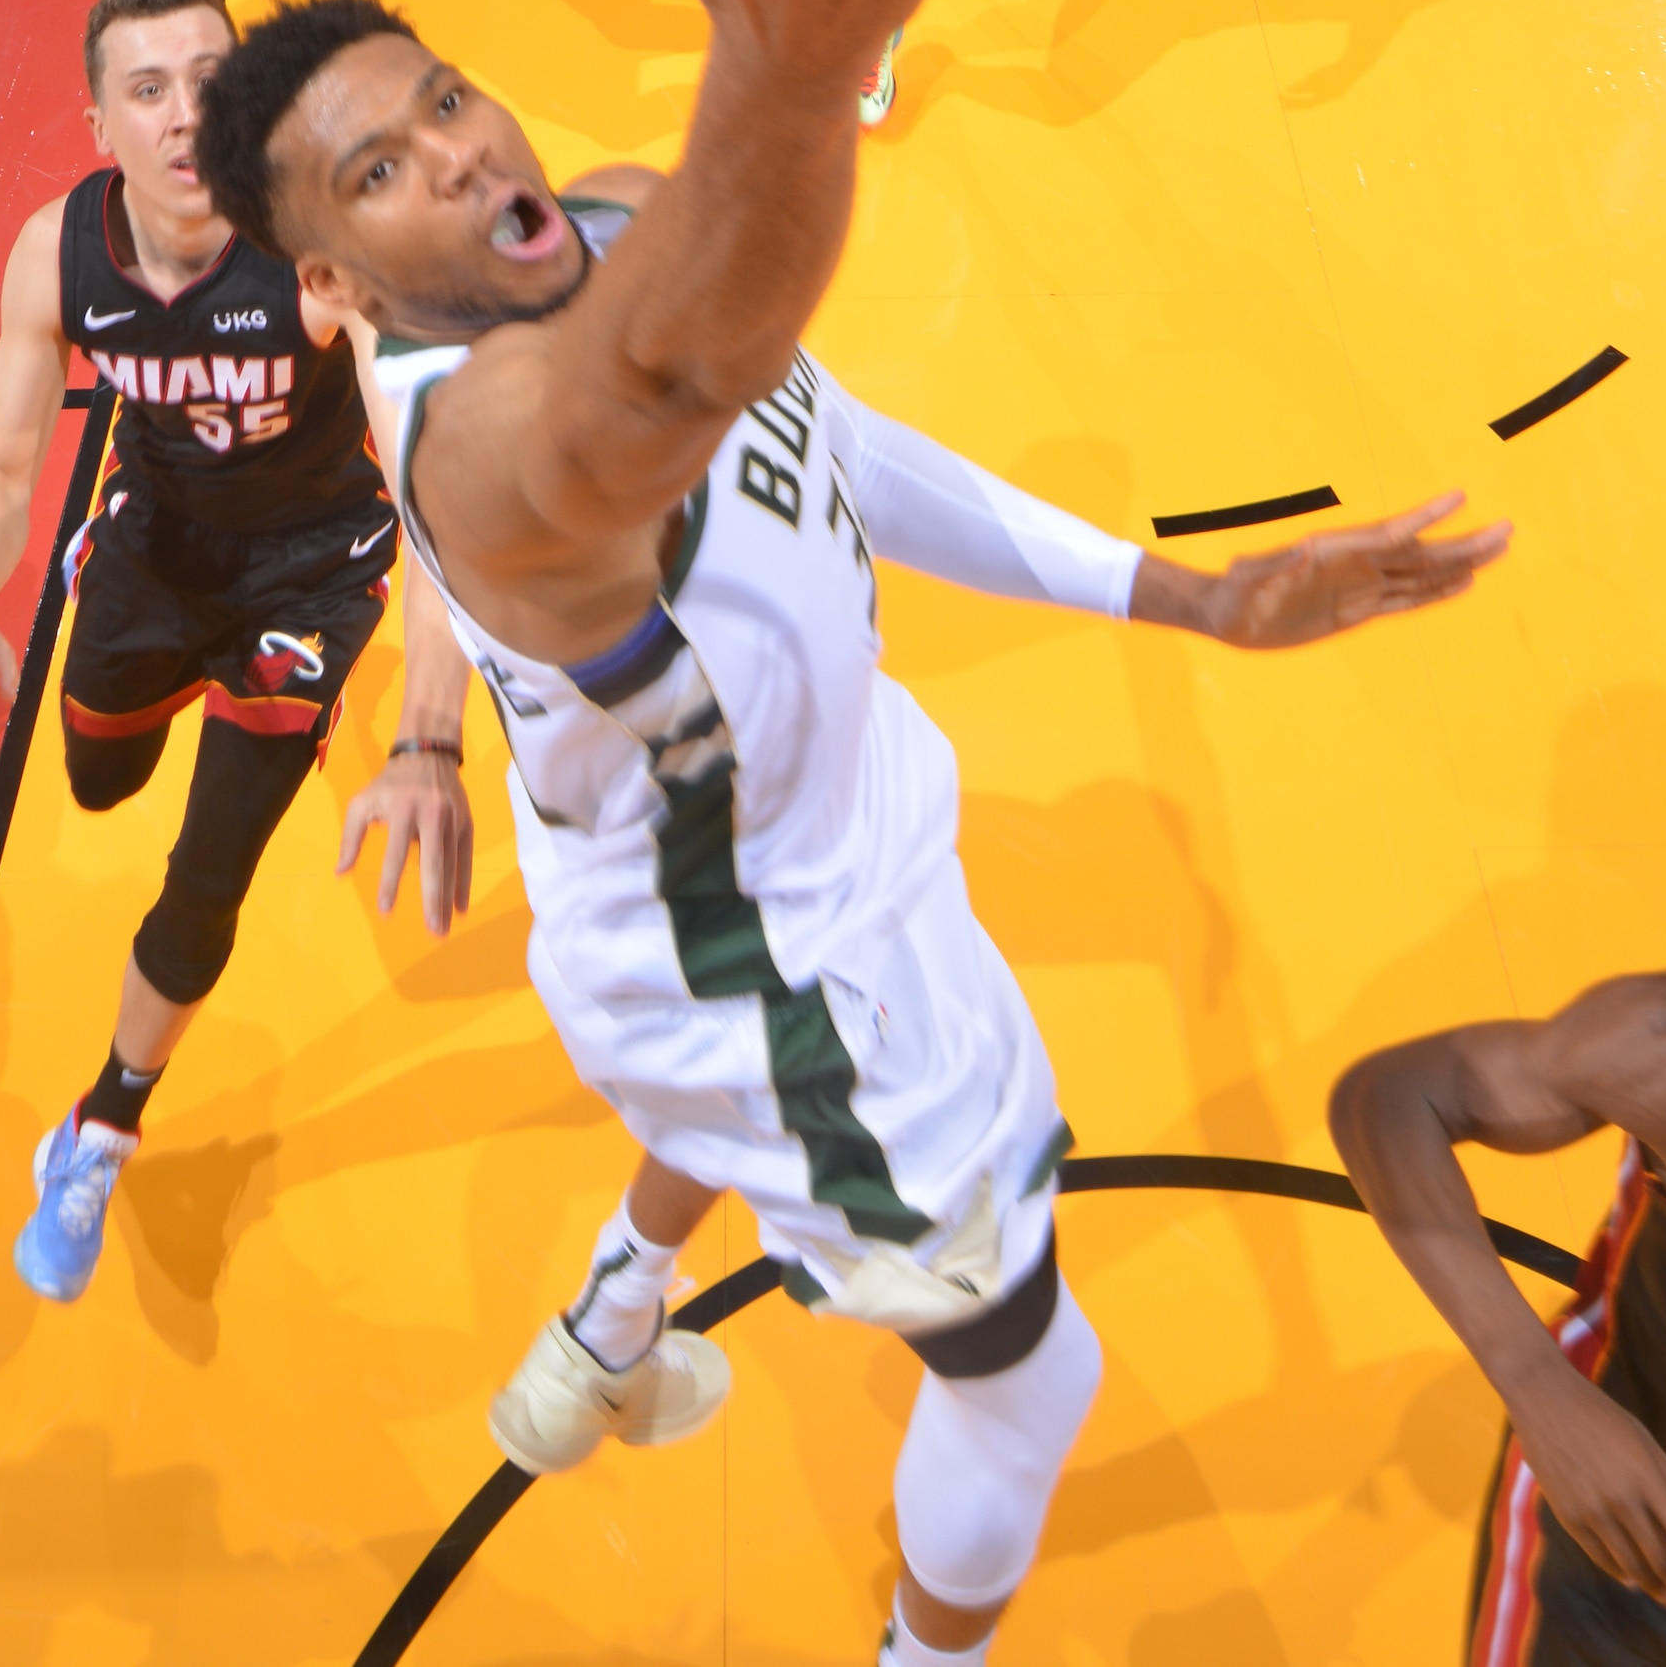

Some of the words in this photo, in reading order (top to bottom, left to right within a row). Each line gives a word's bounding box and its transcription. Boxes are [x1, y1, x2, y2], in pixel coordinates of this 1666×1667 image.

[213, 309, 268, 333] UKG
[90, 350, 295, 405] MIAMI
[186, 401, 291, 453] 55
